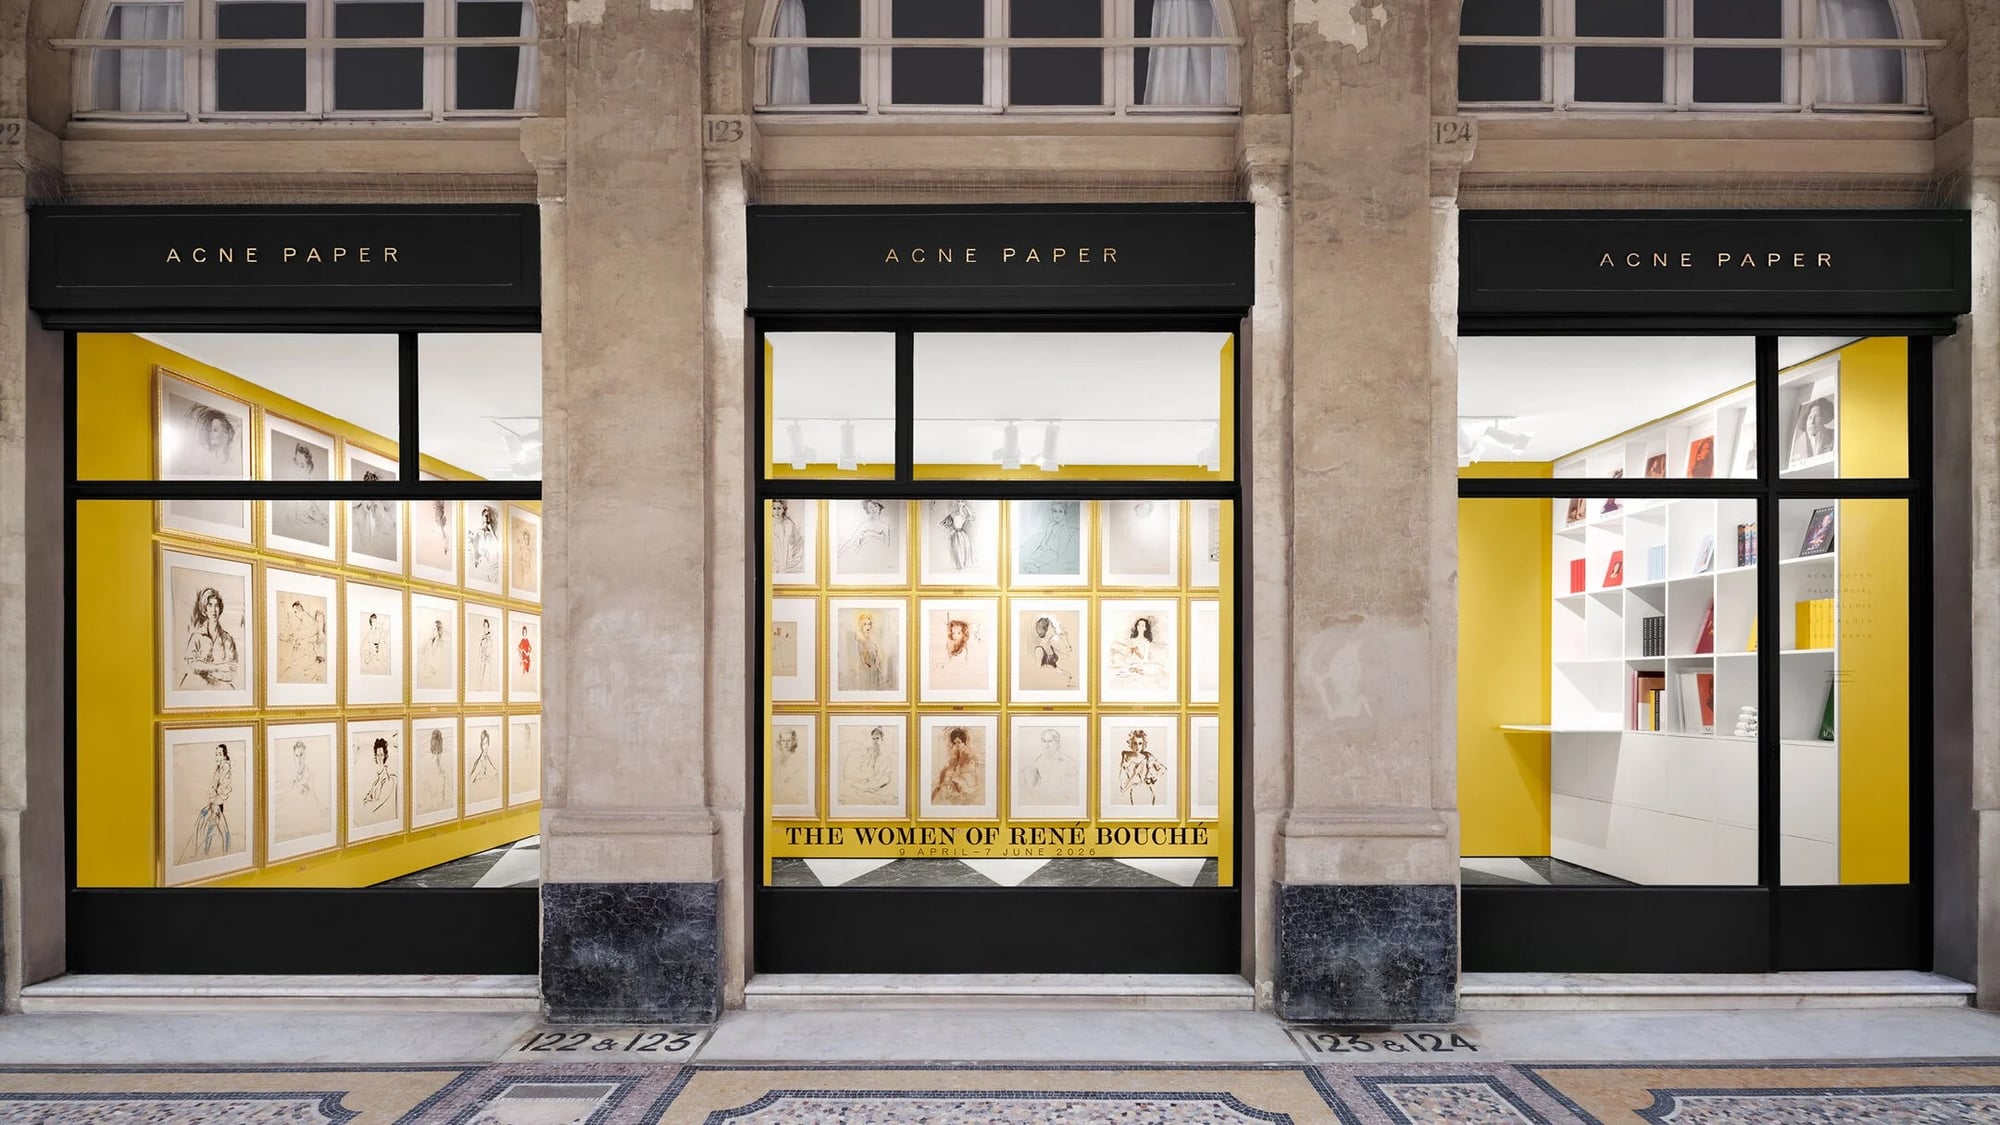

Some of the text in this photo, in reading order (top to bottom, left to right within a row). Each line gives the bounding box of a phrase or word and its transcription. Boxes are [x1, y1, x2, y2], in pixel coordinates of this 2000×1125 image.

[708, 120, 744, 143] 123
[1434, 120, 1473, 144] 124
[166, 247, 398, 263] ACNE PAPER
[885, 248, 1117, 263] ACNE PAPER
[1599, 252, 1832, 268] ACNE PAPER
[786, 821, 1208, 845] THE WOMEN OF RENÉ BOUCHÉ
[899, 848, 905, 856] 9
[1003, 848, 1045, 856] JUNE
[1056, 848, 1096, 856] 2026
[518, 1032, 697, 1052] 122 & 123
[1304, 1033, 1479, 1052] 123 & 124
